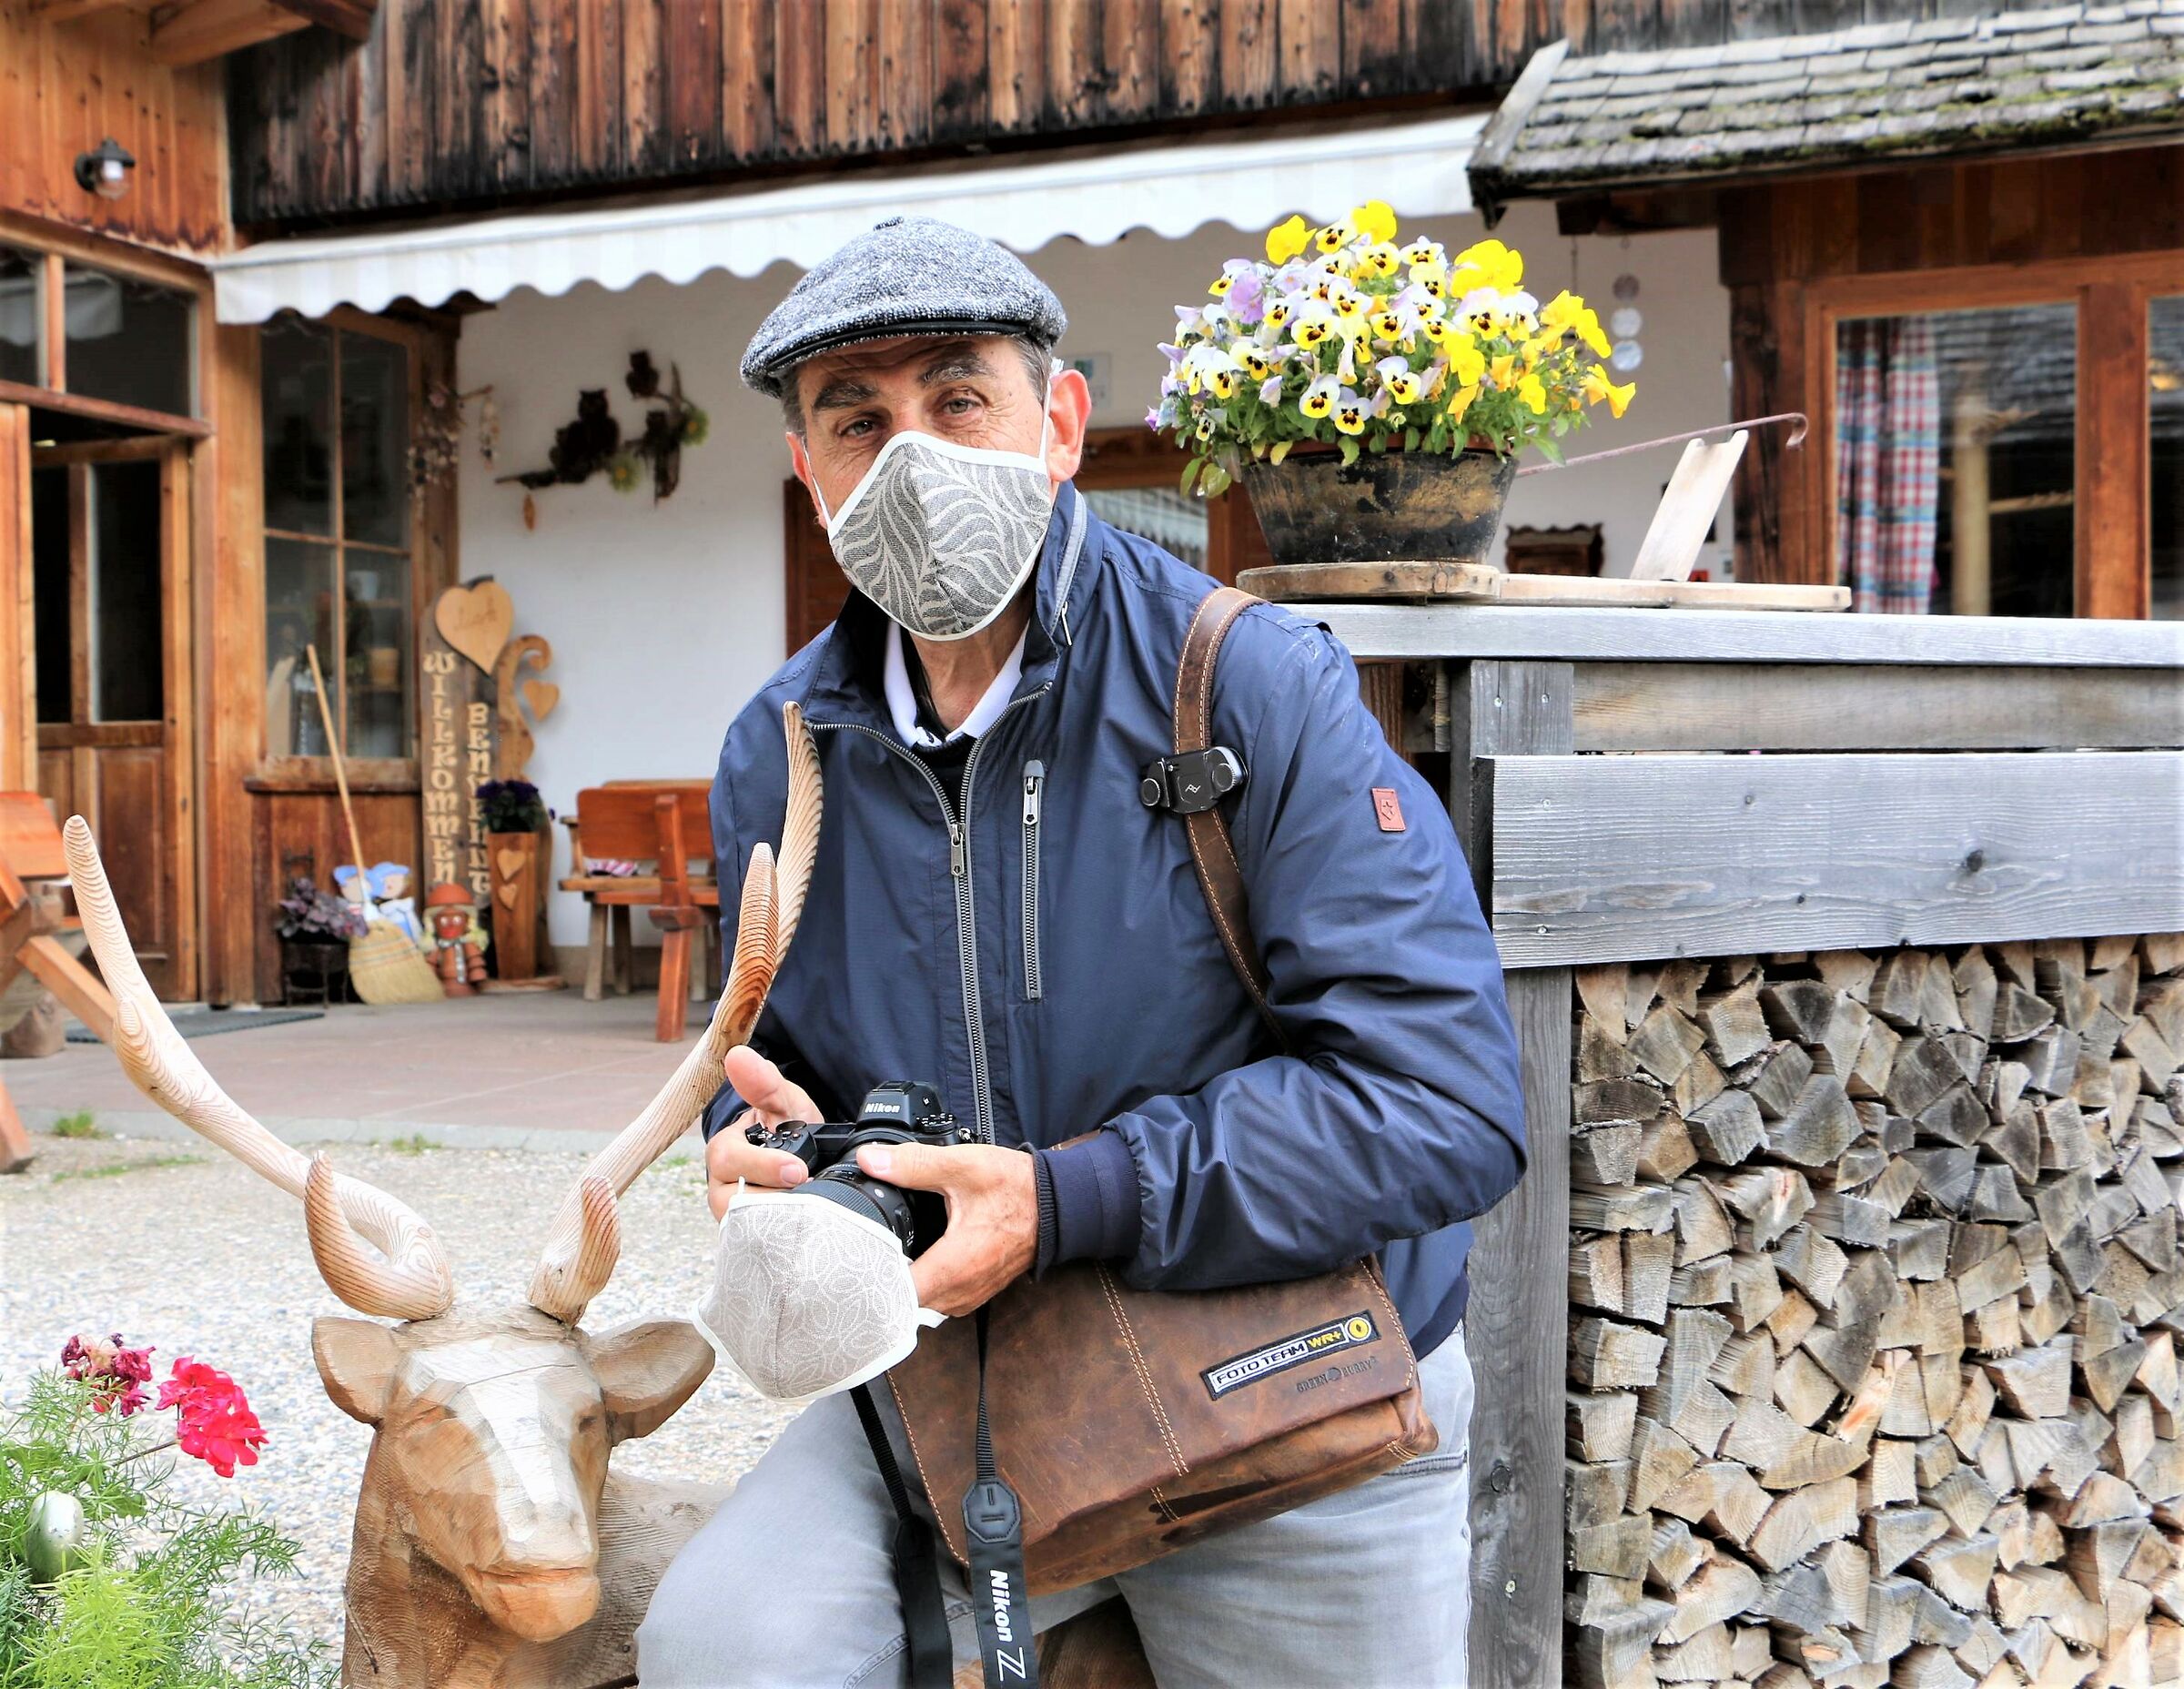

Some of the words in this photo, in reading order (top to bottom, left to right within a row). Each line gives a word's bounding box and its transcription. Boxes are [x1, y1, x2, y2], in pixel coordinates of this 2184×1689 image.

[422, 651, 460, 885] WILLKOMMEN
[864, 1102, 901, 1113] Nikon
[1217, 1360, 1260, 1384] FOTO
[1261, 1342, 1306, 1365] TEAM
[1307, 1330, 1342, 1348] WR+
[989, 1569, 1013, 1643] Nikon
[996, 1646, 1026, 1682] Z
